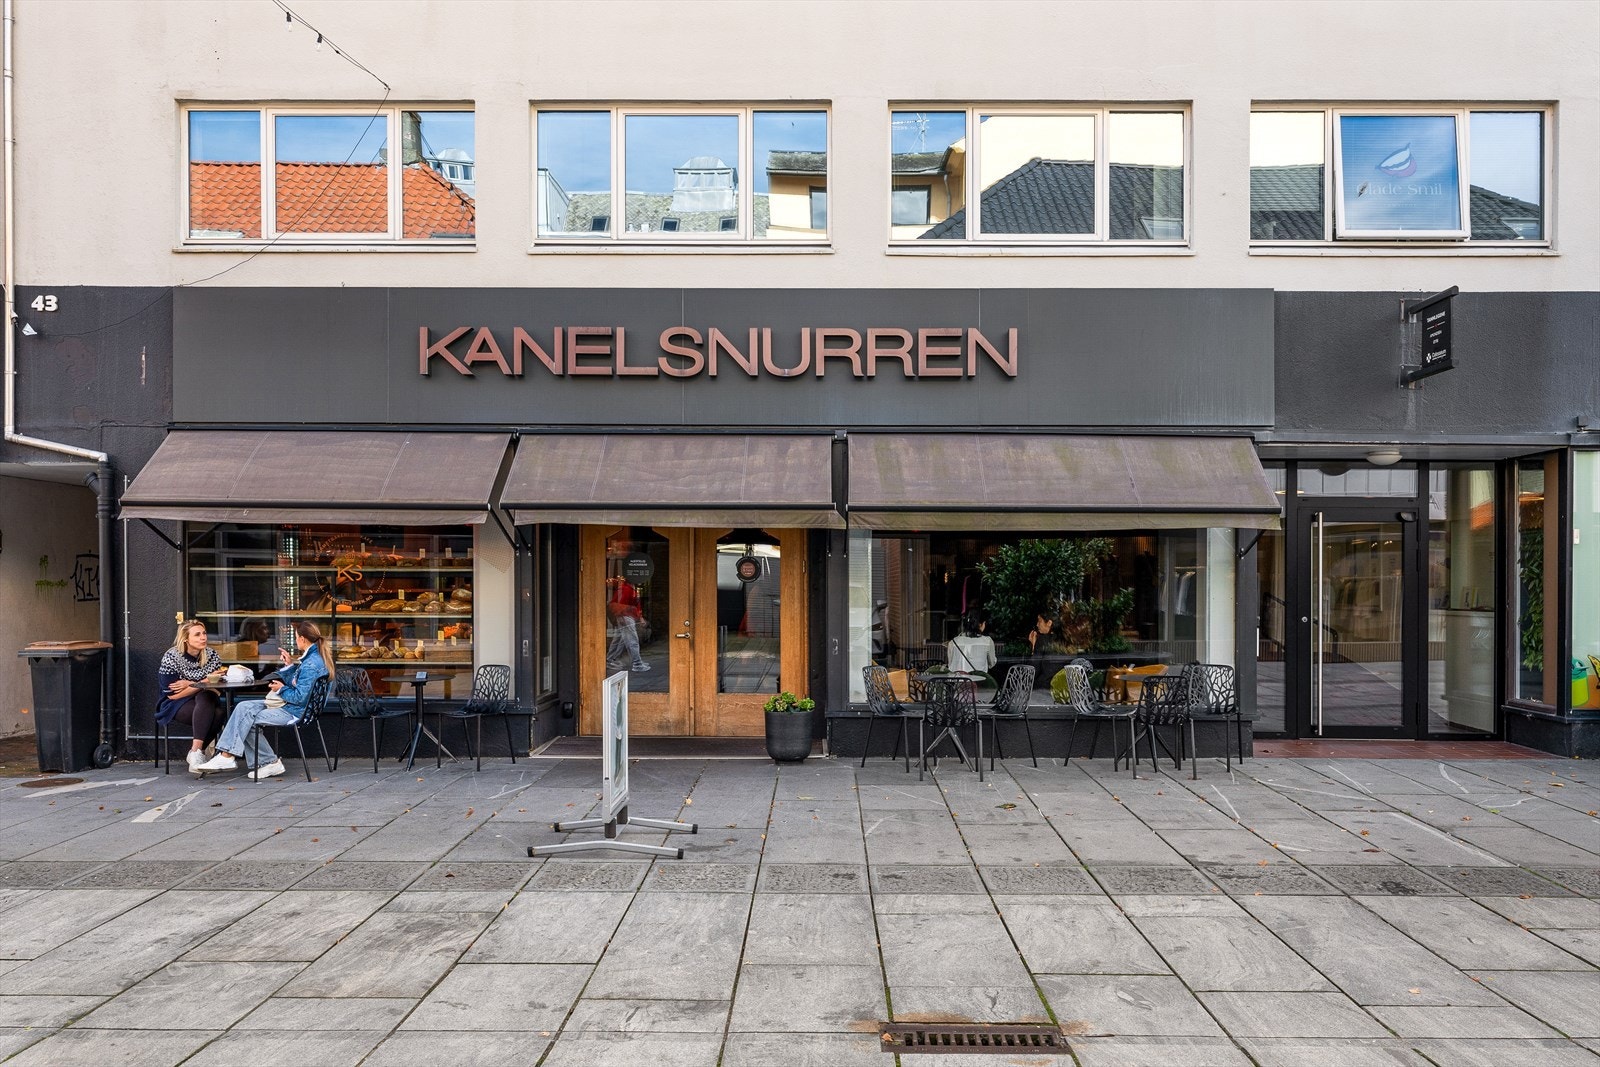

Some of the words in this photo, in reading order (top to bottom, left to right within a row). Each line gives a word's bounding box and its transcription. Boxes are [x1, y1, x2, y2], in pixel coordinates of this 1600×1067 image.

[1407, 183, 1442, 196] Smil
[31, 294, 59, 312] 43
[419, 326, 1018, 378] KANELSNURREN
[337, 563, 363, 582] KS
